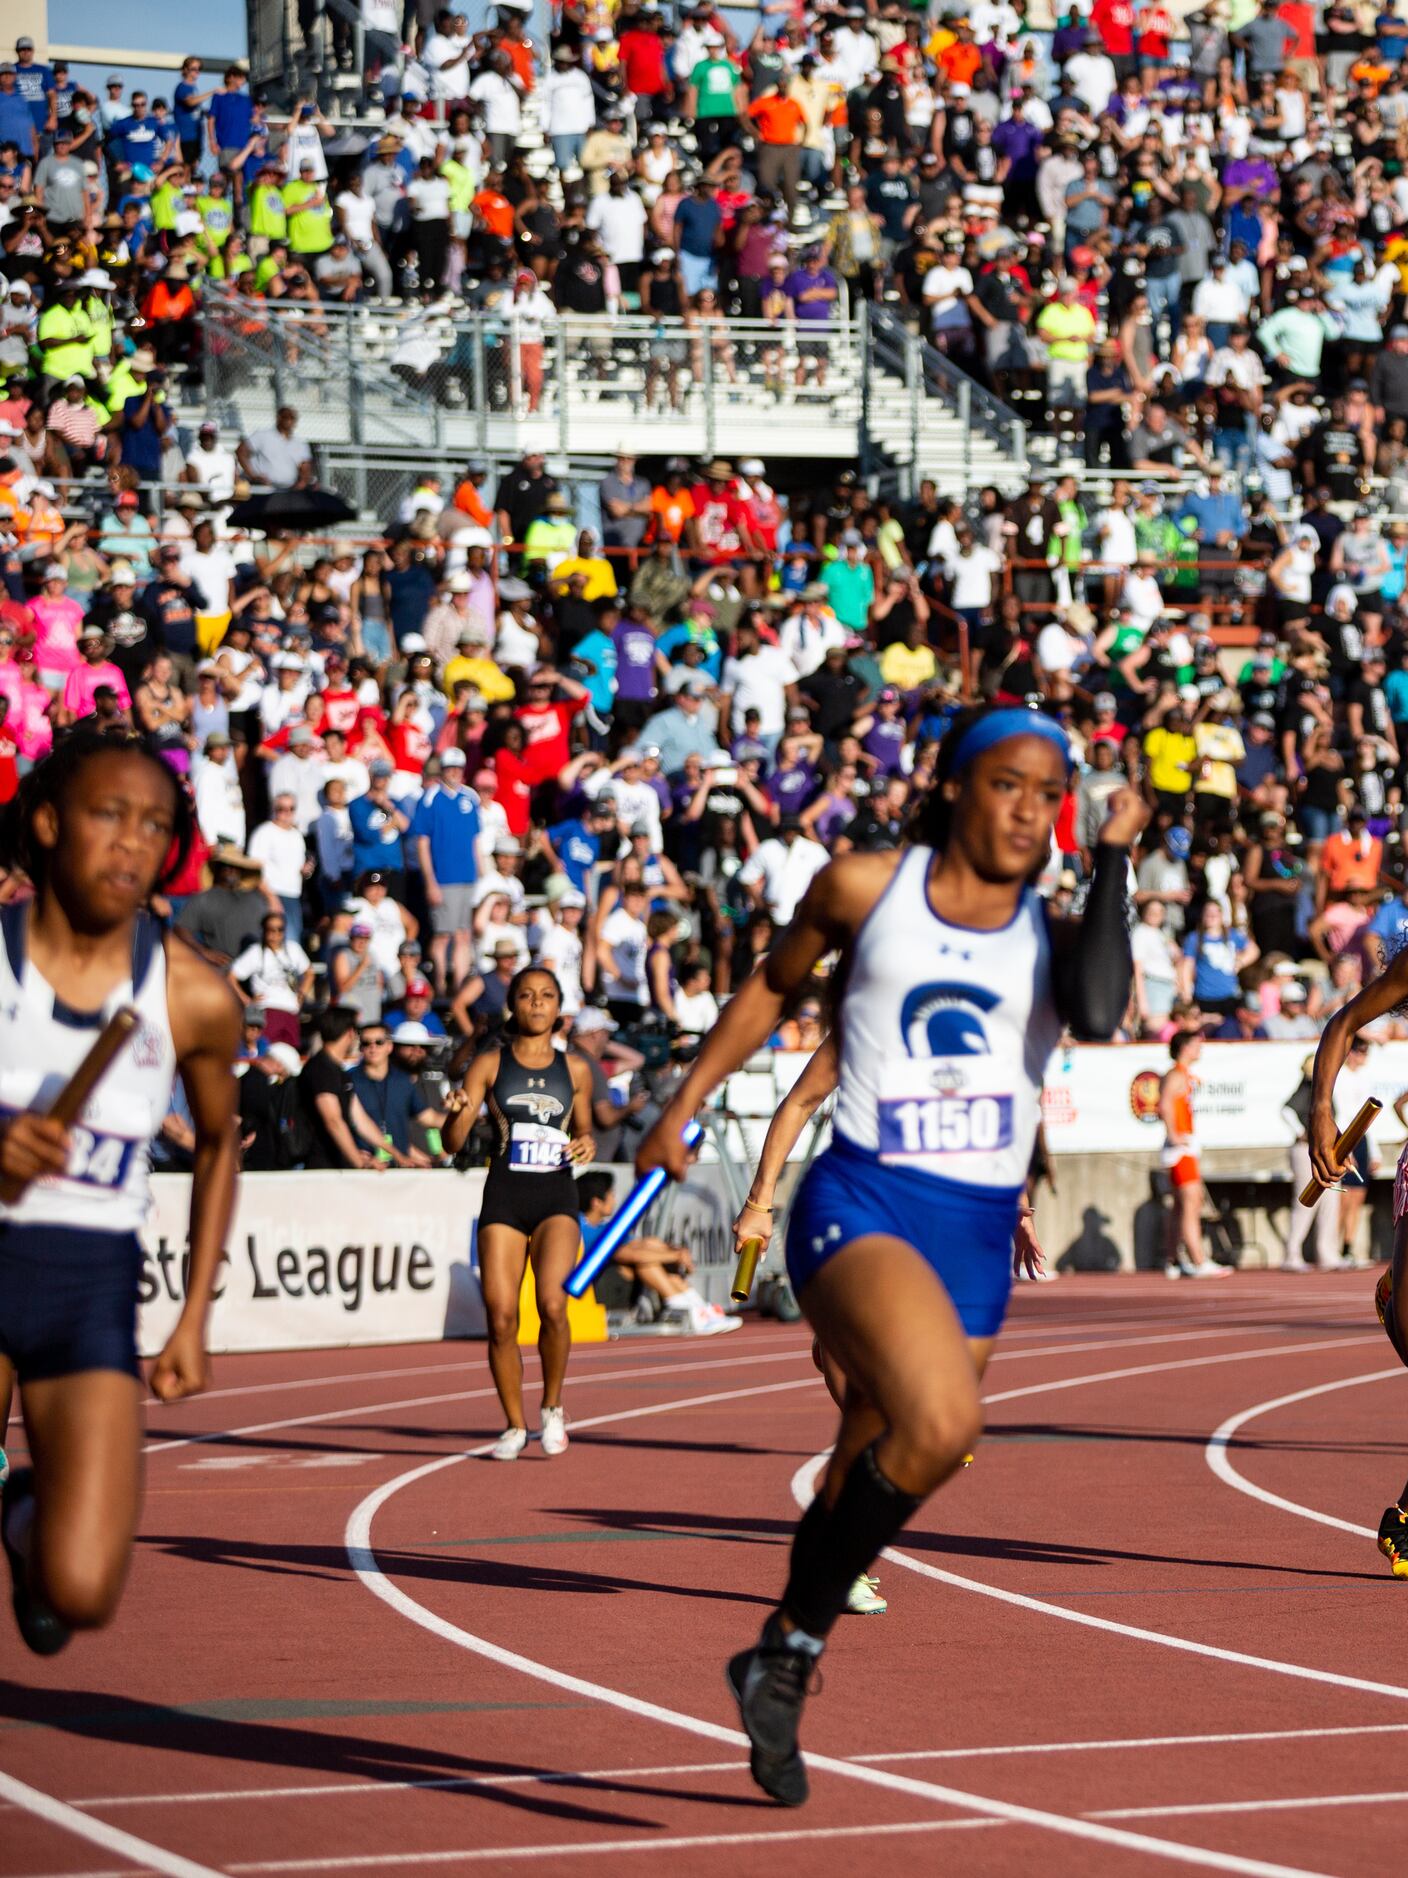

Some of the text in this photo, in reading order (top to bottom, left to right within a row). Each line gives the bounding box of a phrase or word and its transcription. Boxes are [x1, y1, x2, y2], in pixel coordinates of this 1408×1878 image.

[65, 1125, 126, 1184] 34
[894, 1098, 1001, 1153] 1150
[247, 1232, 435, 1311] League
